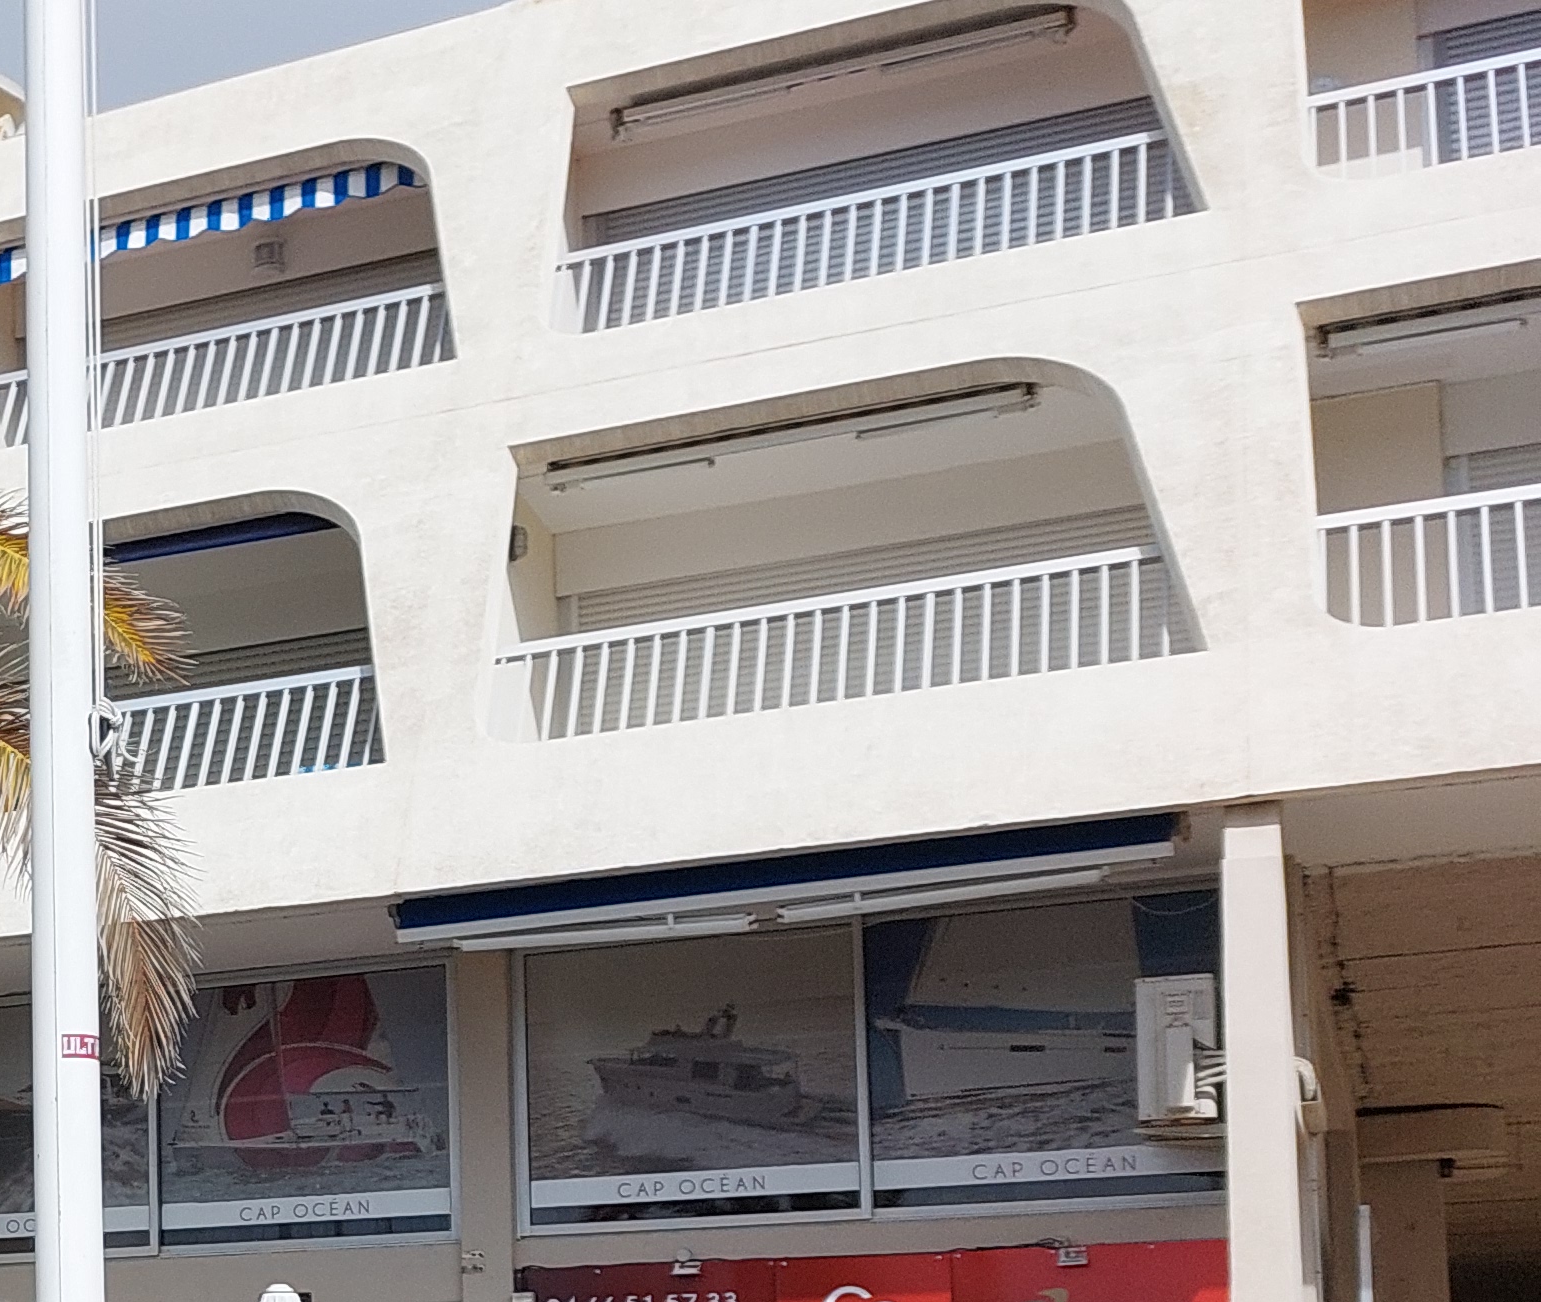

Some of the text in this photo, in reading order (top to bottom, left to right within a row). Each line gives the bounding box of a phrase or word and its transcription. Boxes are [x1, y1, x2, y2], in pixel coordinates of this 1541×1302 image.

[972, 1155, 1138, 1180] CAP OCÉAN
[618, 1174, 767, 1198] CAP OCÉAN
[239, 1199, 372, 1222] CAP OCÉAN
